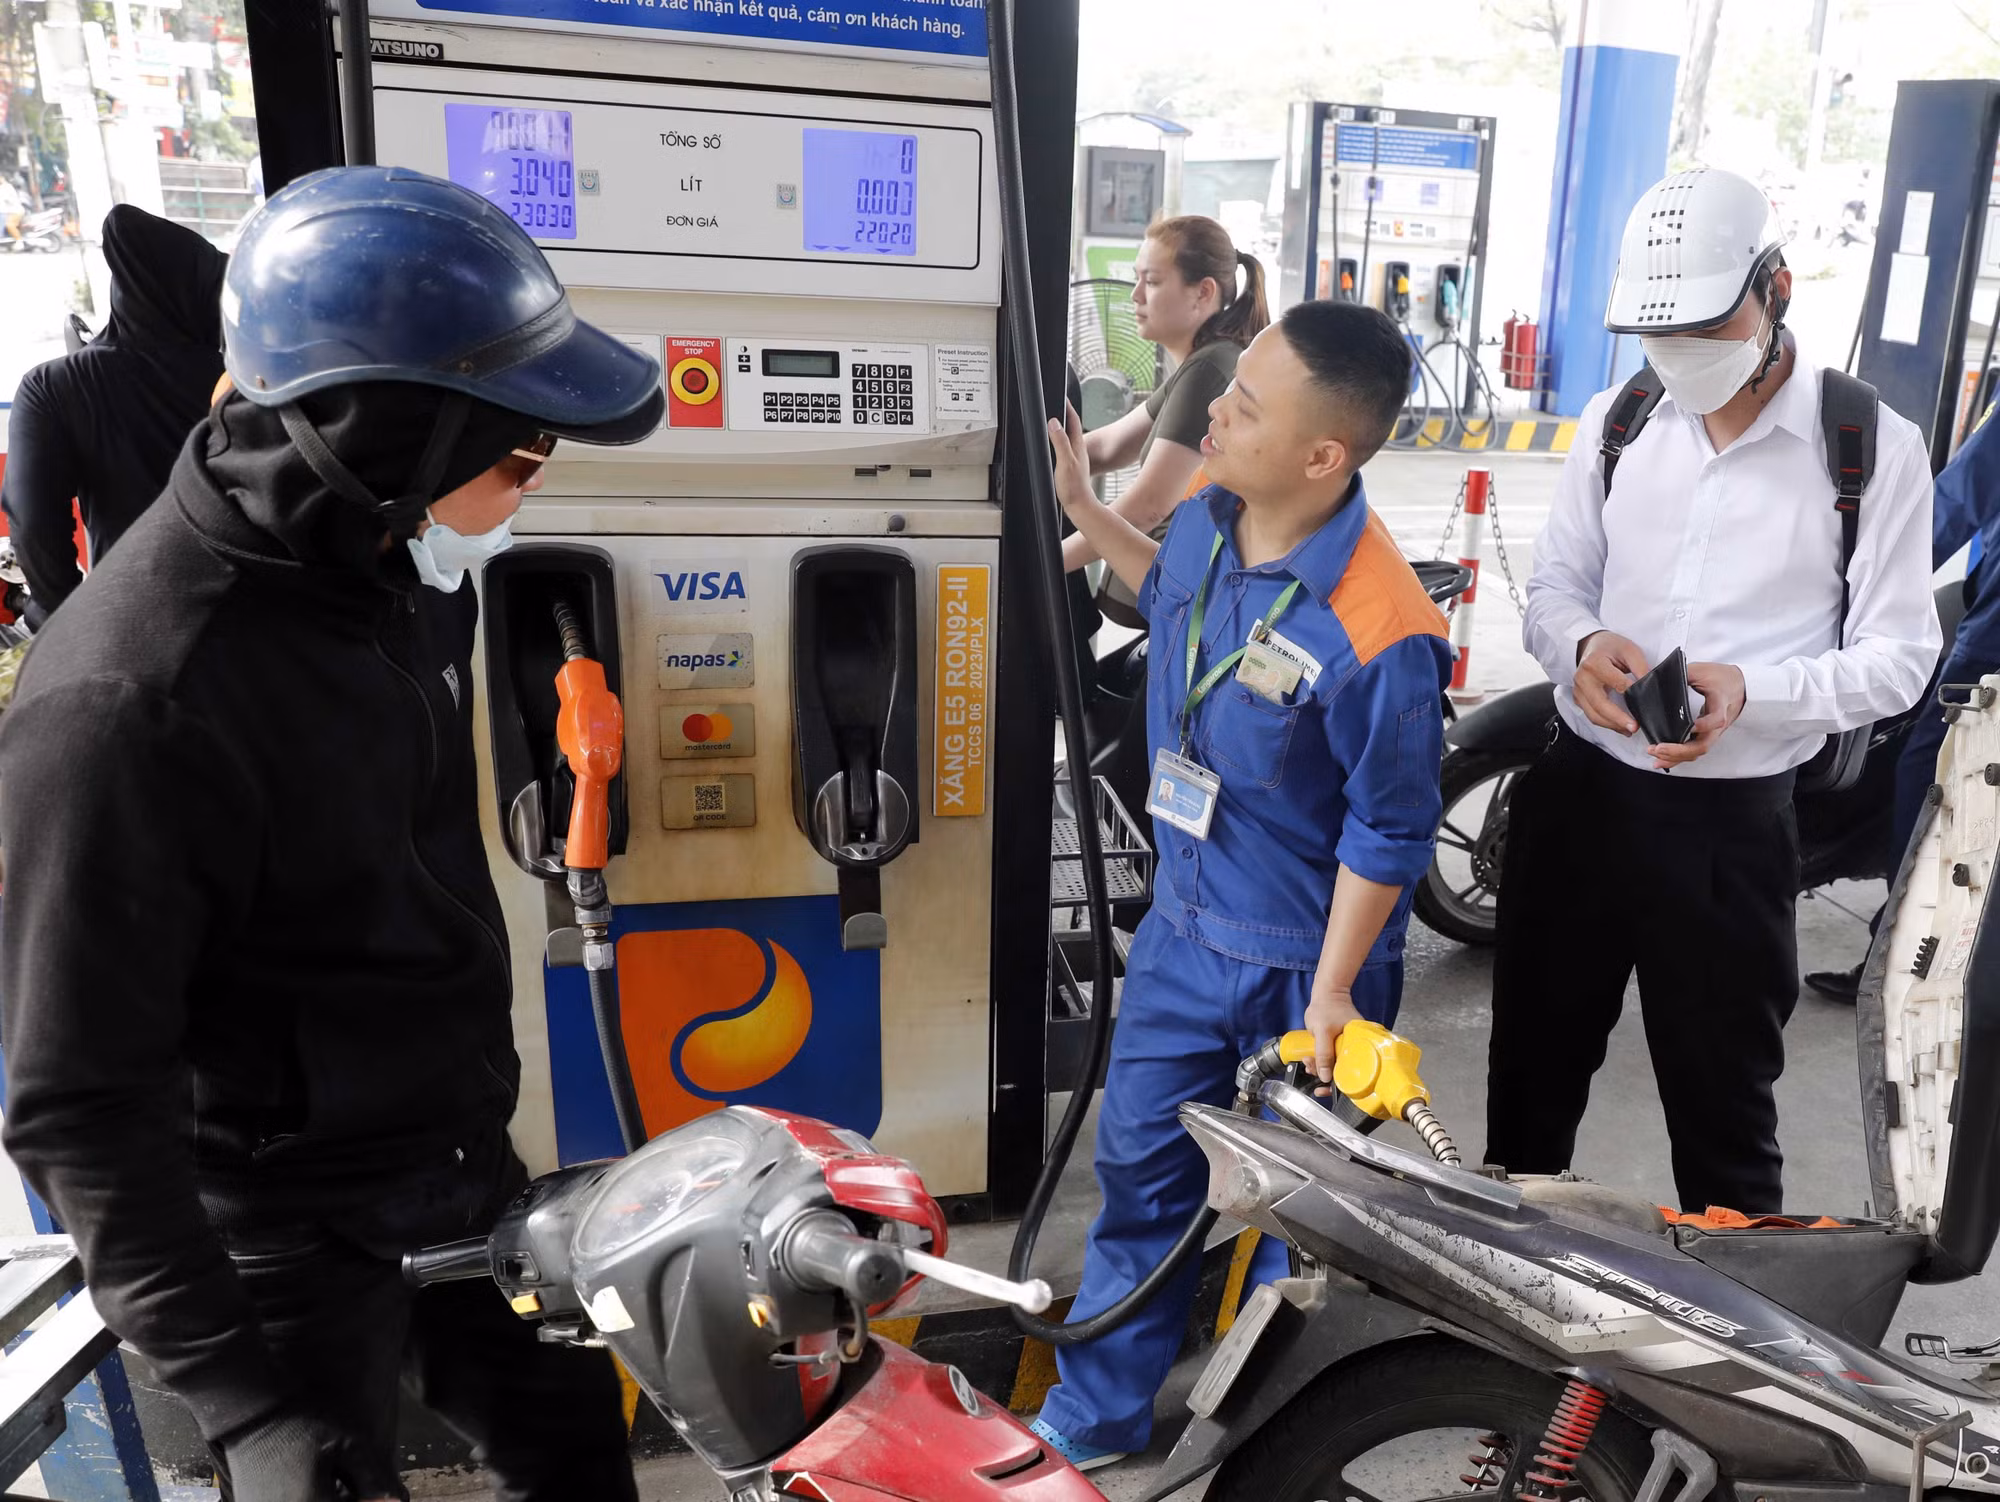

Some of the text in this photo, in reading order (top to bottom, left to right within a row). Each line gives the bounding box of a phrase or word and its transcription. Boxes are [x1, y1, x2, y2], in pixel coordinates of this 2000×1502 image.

[768, 4, 802, 23] quả,
[807, 7, 840, 24] cám
[845, 13, 867, 26] ơn
[871, 12, 918, 31] khách
[923, 20, 966, 38] hàng.
[660, 130, 722, 149] TỔNG SỐ
[901, 139, 915, 175] 0
[680, 175, 703, 192] LÍT
[666, 214, 719, 228] ĐƠN GIÁ
[855, 220, 912, 245] 22020
[671, 339, 715, 348] EMERGENCY
[684, 347, 704, 355] STOP
[937, 348, 989, 357] Preset Instruction
[854, 365, 909, 377] 7 8 9 F1
[855, 381, 911, 393] 4 5 6 F2
[765, 395, 840, 406] P1 P2 P3 P4 P5
[856, 396, 911, 408] 1 2 3 F3
[765, 411, 841, 421] P6 P7 P8 P9 P10
[856, 412, 911, 423] 0 C F4
[653, 571, 746, 601] VISA
[969, 616, 984, 689] 2023/PLX
[667, 653, 726, 672] napas
[940, 577, 968, 807] XĂNG E5 RON92-II
[969, 703, 982, 721] 06
[684, 742, 731, 752] mastercard
[968, 725, 982, 768] TCCS
[693, 813, 727, 822] QR CODE
